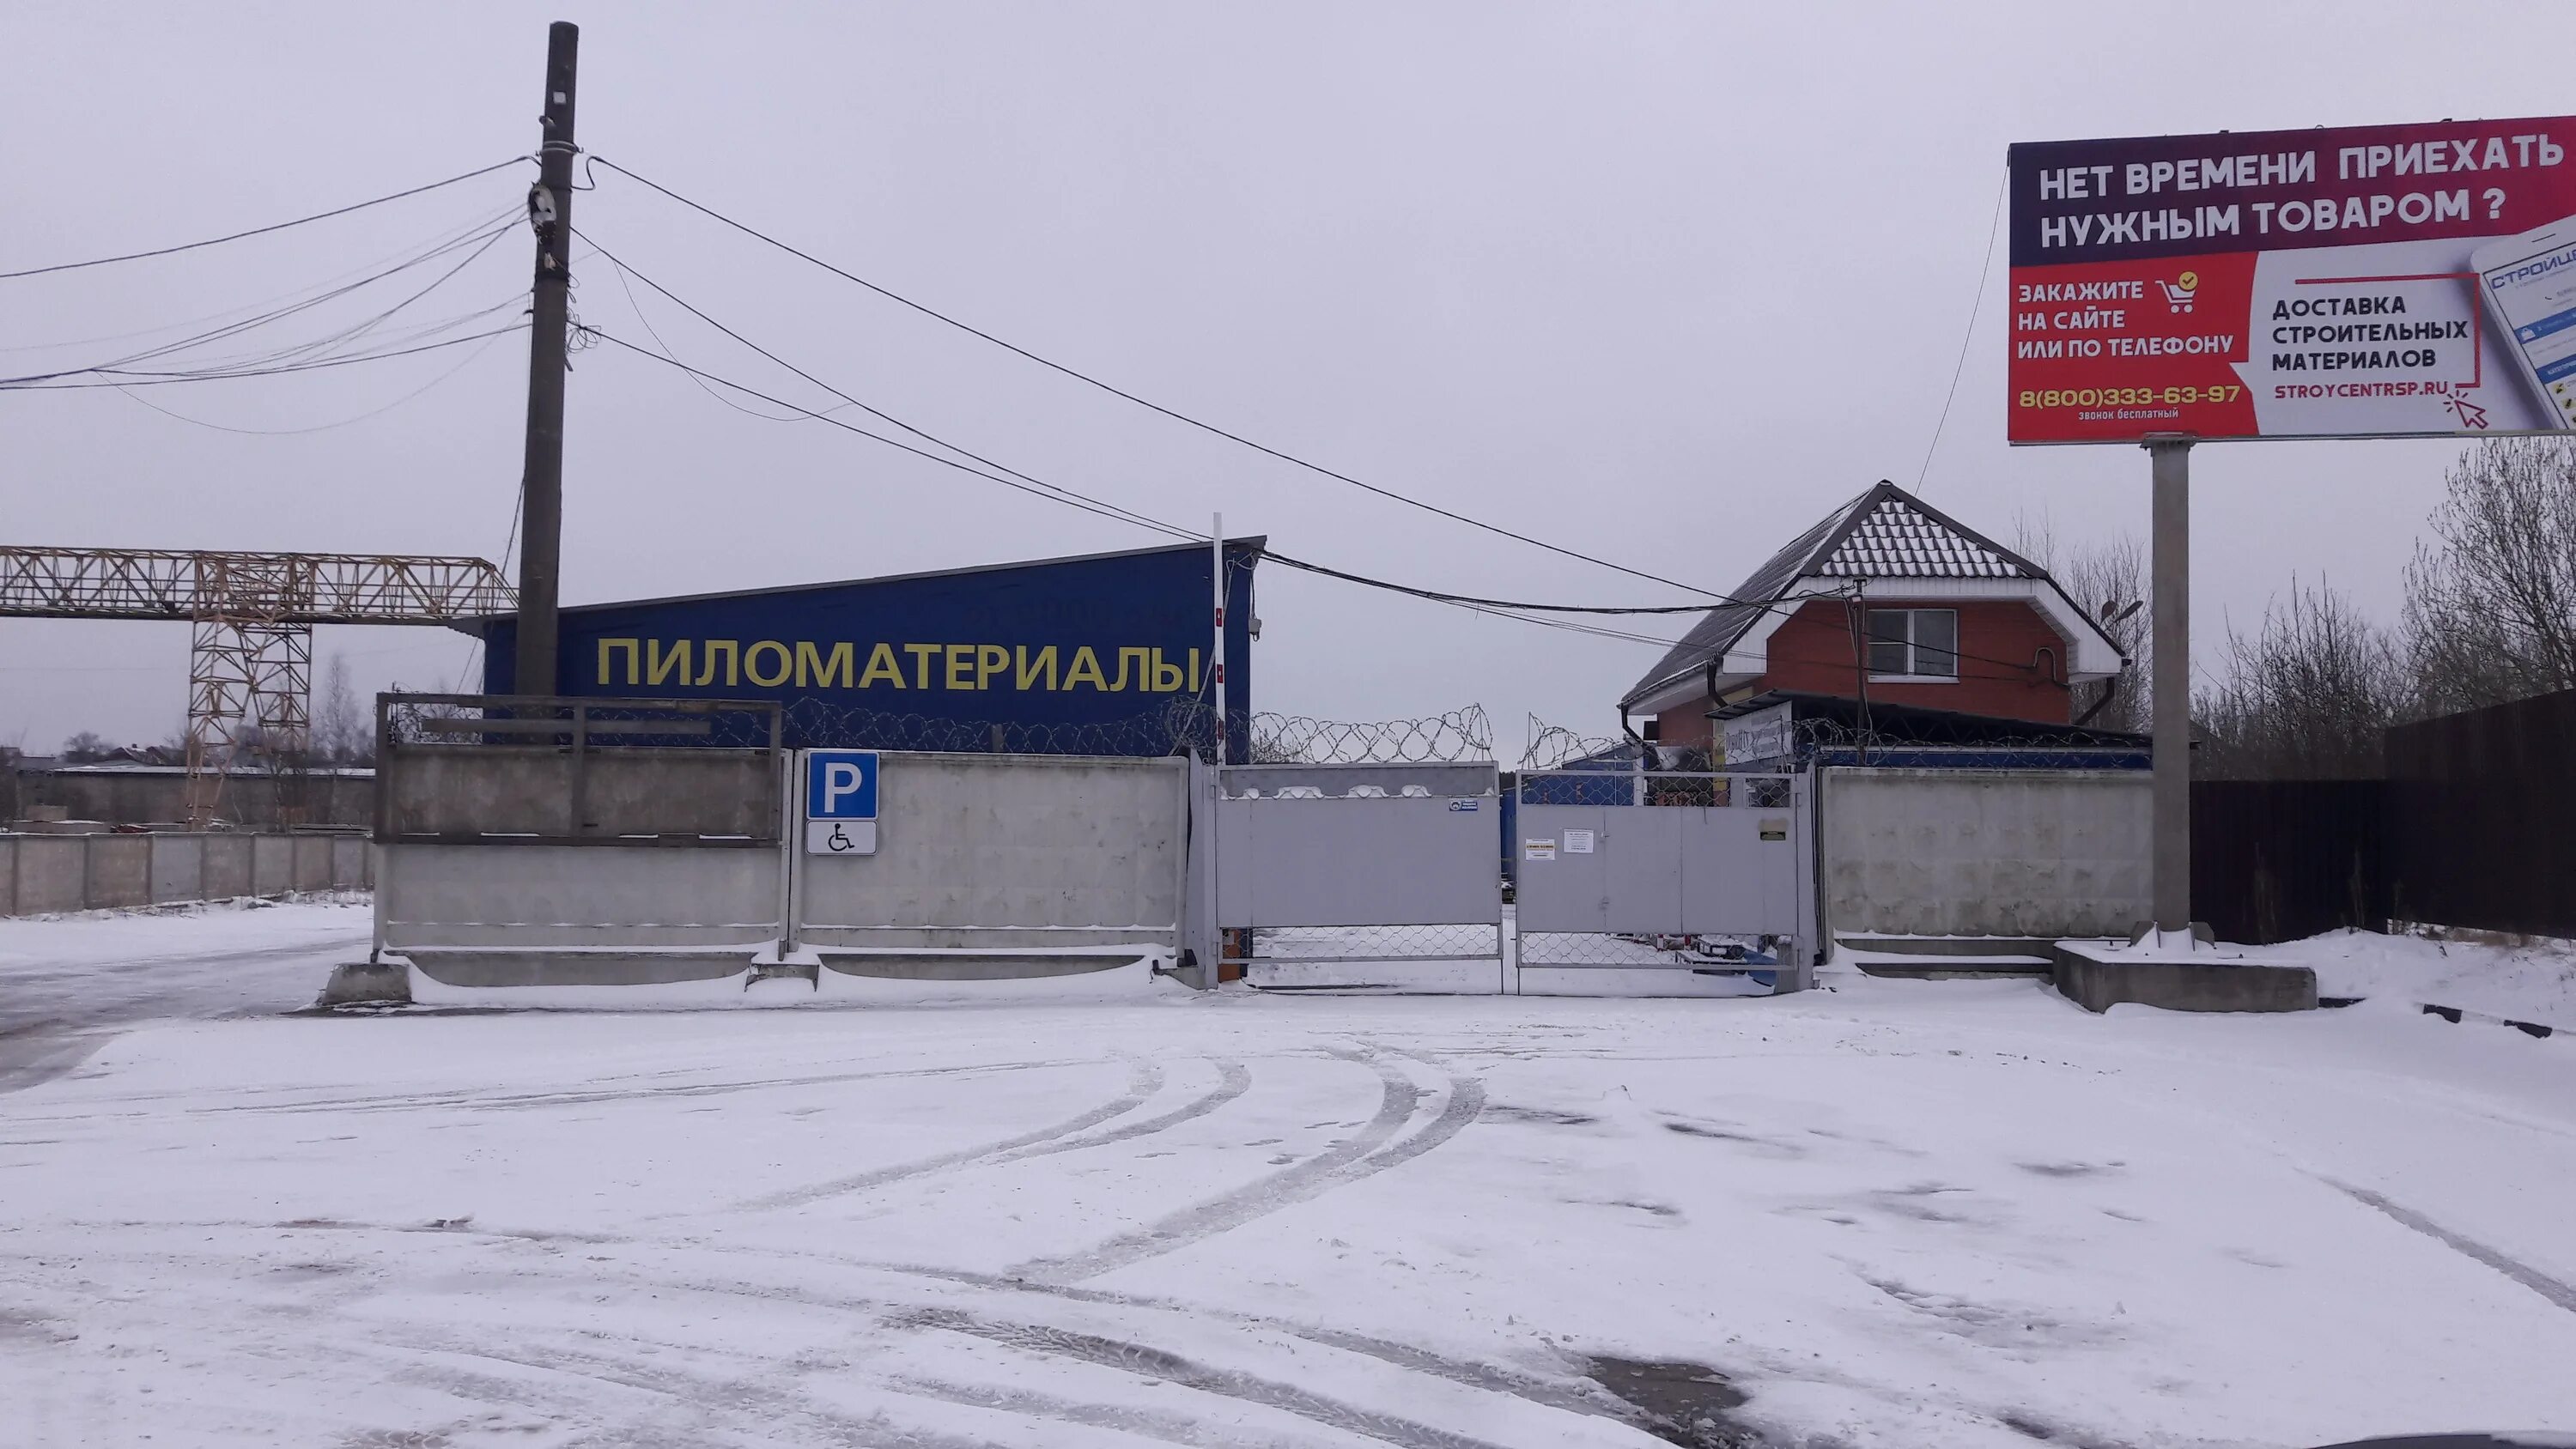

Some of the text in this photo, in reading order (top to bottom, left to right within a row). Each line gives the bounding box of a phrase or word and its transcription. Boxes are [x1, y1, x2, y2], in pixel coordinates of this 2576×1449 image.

[2040, 133, 2565, 201] НЕТ ВРЕМЕНИ ПРИЕХАТЬ
[2040, 187, 2506, 248] НУЖНЫМ ТОВАРОМ ?
[2018, 281, 2144, 303] ЗАКАЖИТЕ
[2018, 305, 2125, 330] НА САЙТЕ
[2272, 295, 2407, 321] ДОСТАВКА
[2272, 320, 2469, 344] СТРОИТЕЛЬНЫХ
[2017, 335, 2234, 359] ИЛИ ПО ТЕЛЕФОНУ
[2272, 349, 2437, 371] МАТЕРИАЛОВ
[2019, 385, 2241, 409] 8(800)333-63-97
[2275, 381, 2449, 399] STROYCENTRSP.RU
[2078, 407, 2179, 421] звонок бесплатный
[596, 638, 1200, 693] ПИЛОМАТЕРИАЛЫ
[824, 762, 863, 814] P
